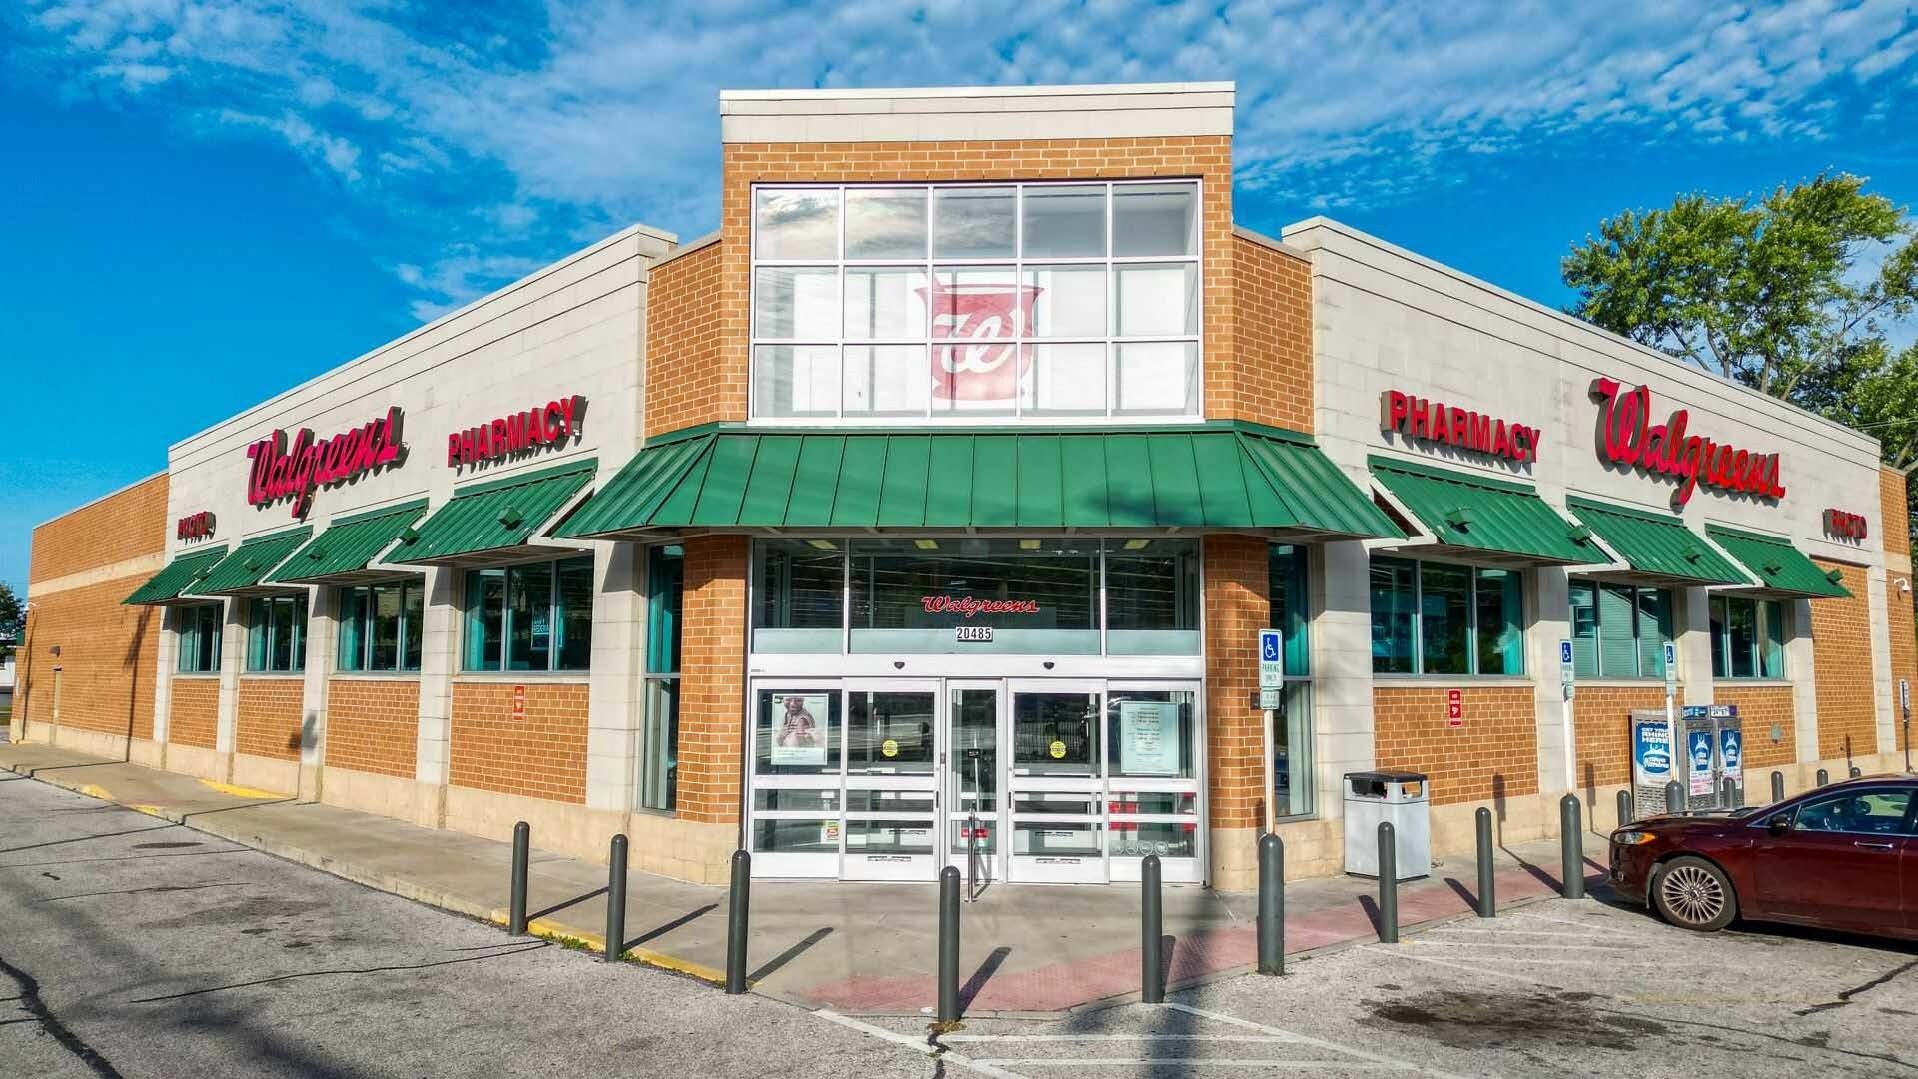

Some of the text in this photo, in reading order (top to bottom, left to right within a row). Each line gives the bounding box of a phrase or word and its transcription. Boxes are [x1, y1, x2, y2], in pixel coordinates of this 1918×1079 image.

[247, 406, 402, 519] Walgreens
[447, 394, 586, 469] PHARMACY
[1382, 390, 1541, 463] PHARMACY
[1589, 377, 1786, 512] Walgreens
[921, 595, 1040, 618] Walgreens
[956, 627, 992, 639] 20485
